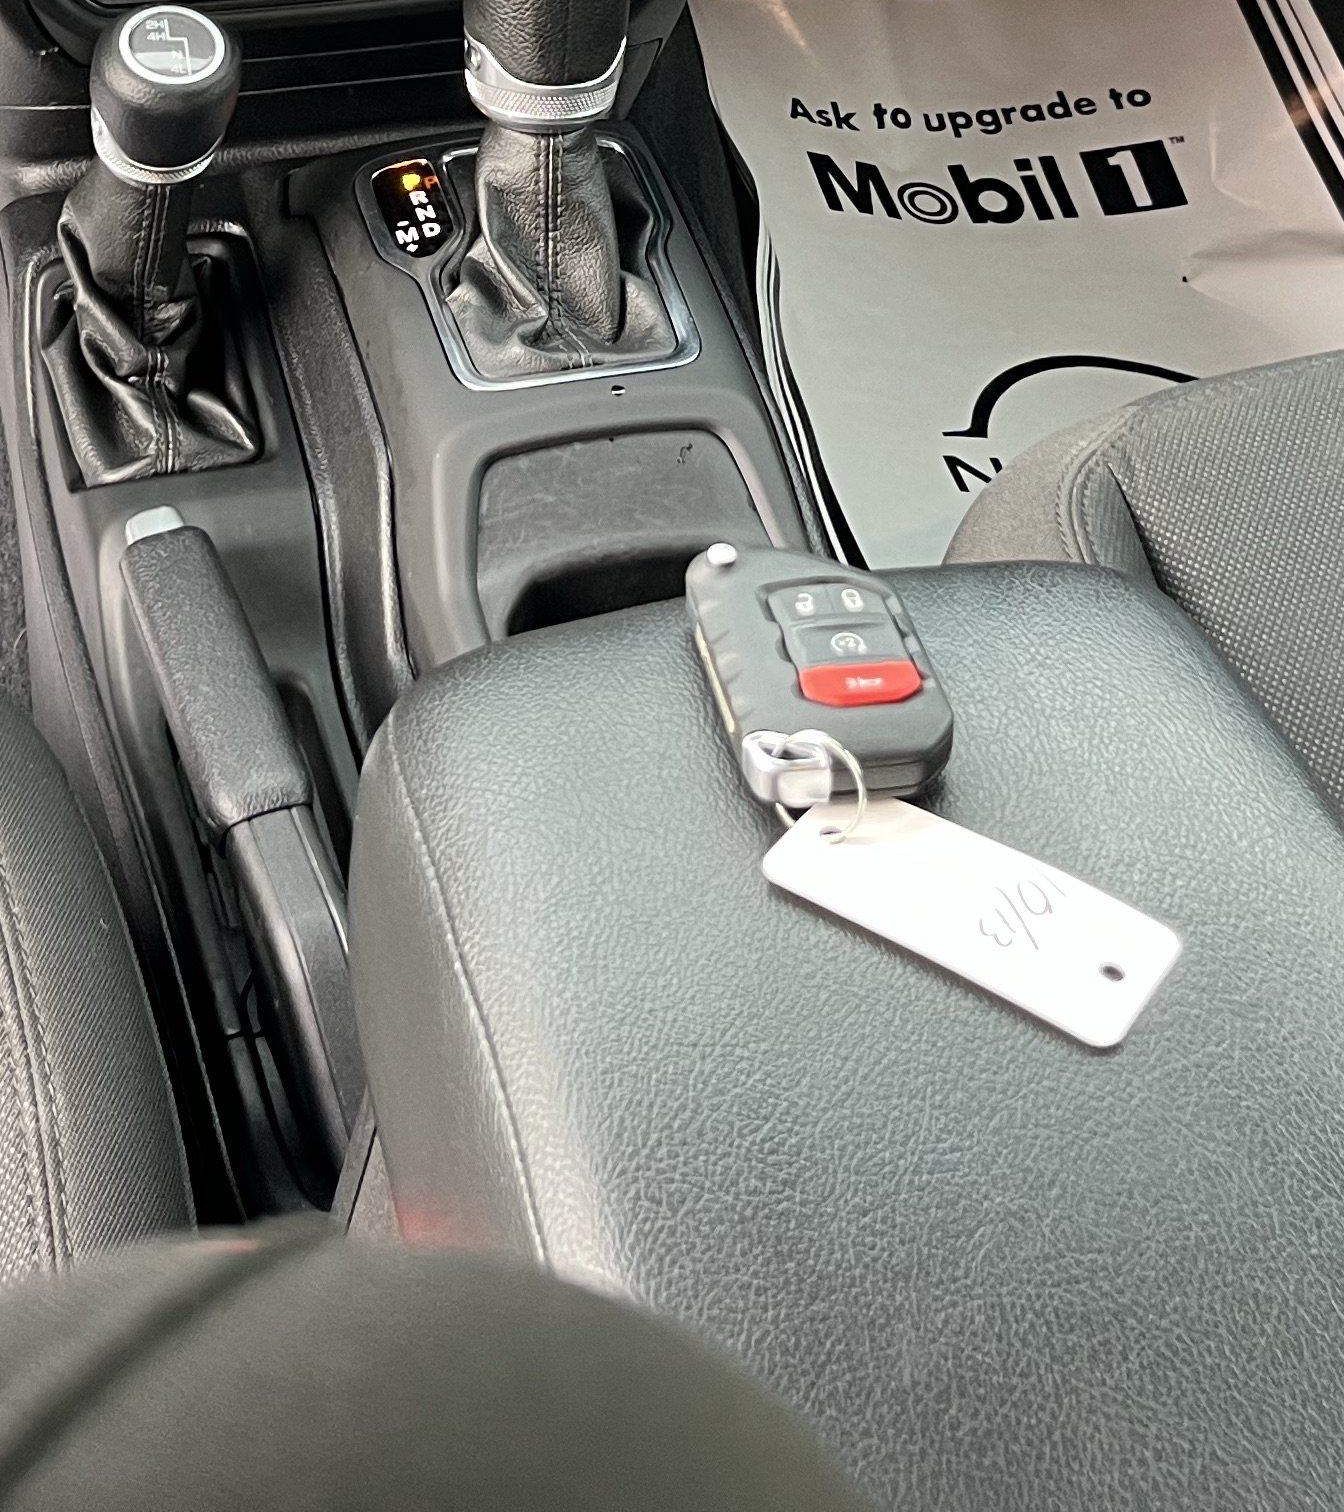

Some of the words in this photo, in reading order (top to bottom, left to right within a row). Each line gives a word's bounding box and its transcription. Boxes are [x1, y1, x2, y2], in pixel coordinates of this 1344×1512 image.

[145, 19, 165, 30] 2H
[146, 31, 166, 41] 4H
[790, 97, 860, 131] Ask
[873, 102, 912, 130] to
[923, 91, 1097, 138] upgrade
[1109, 88, 1152, 109] to
[806, 150, 1079, 225] Mobil
[409, 190, 429, 206] R
[415, 204, 436, 222] N
[395, 226, 420, 245] M
[421, 222, 441, 238] D
